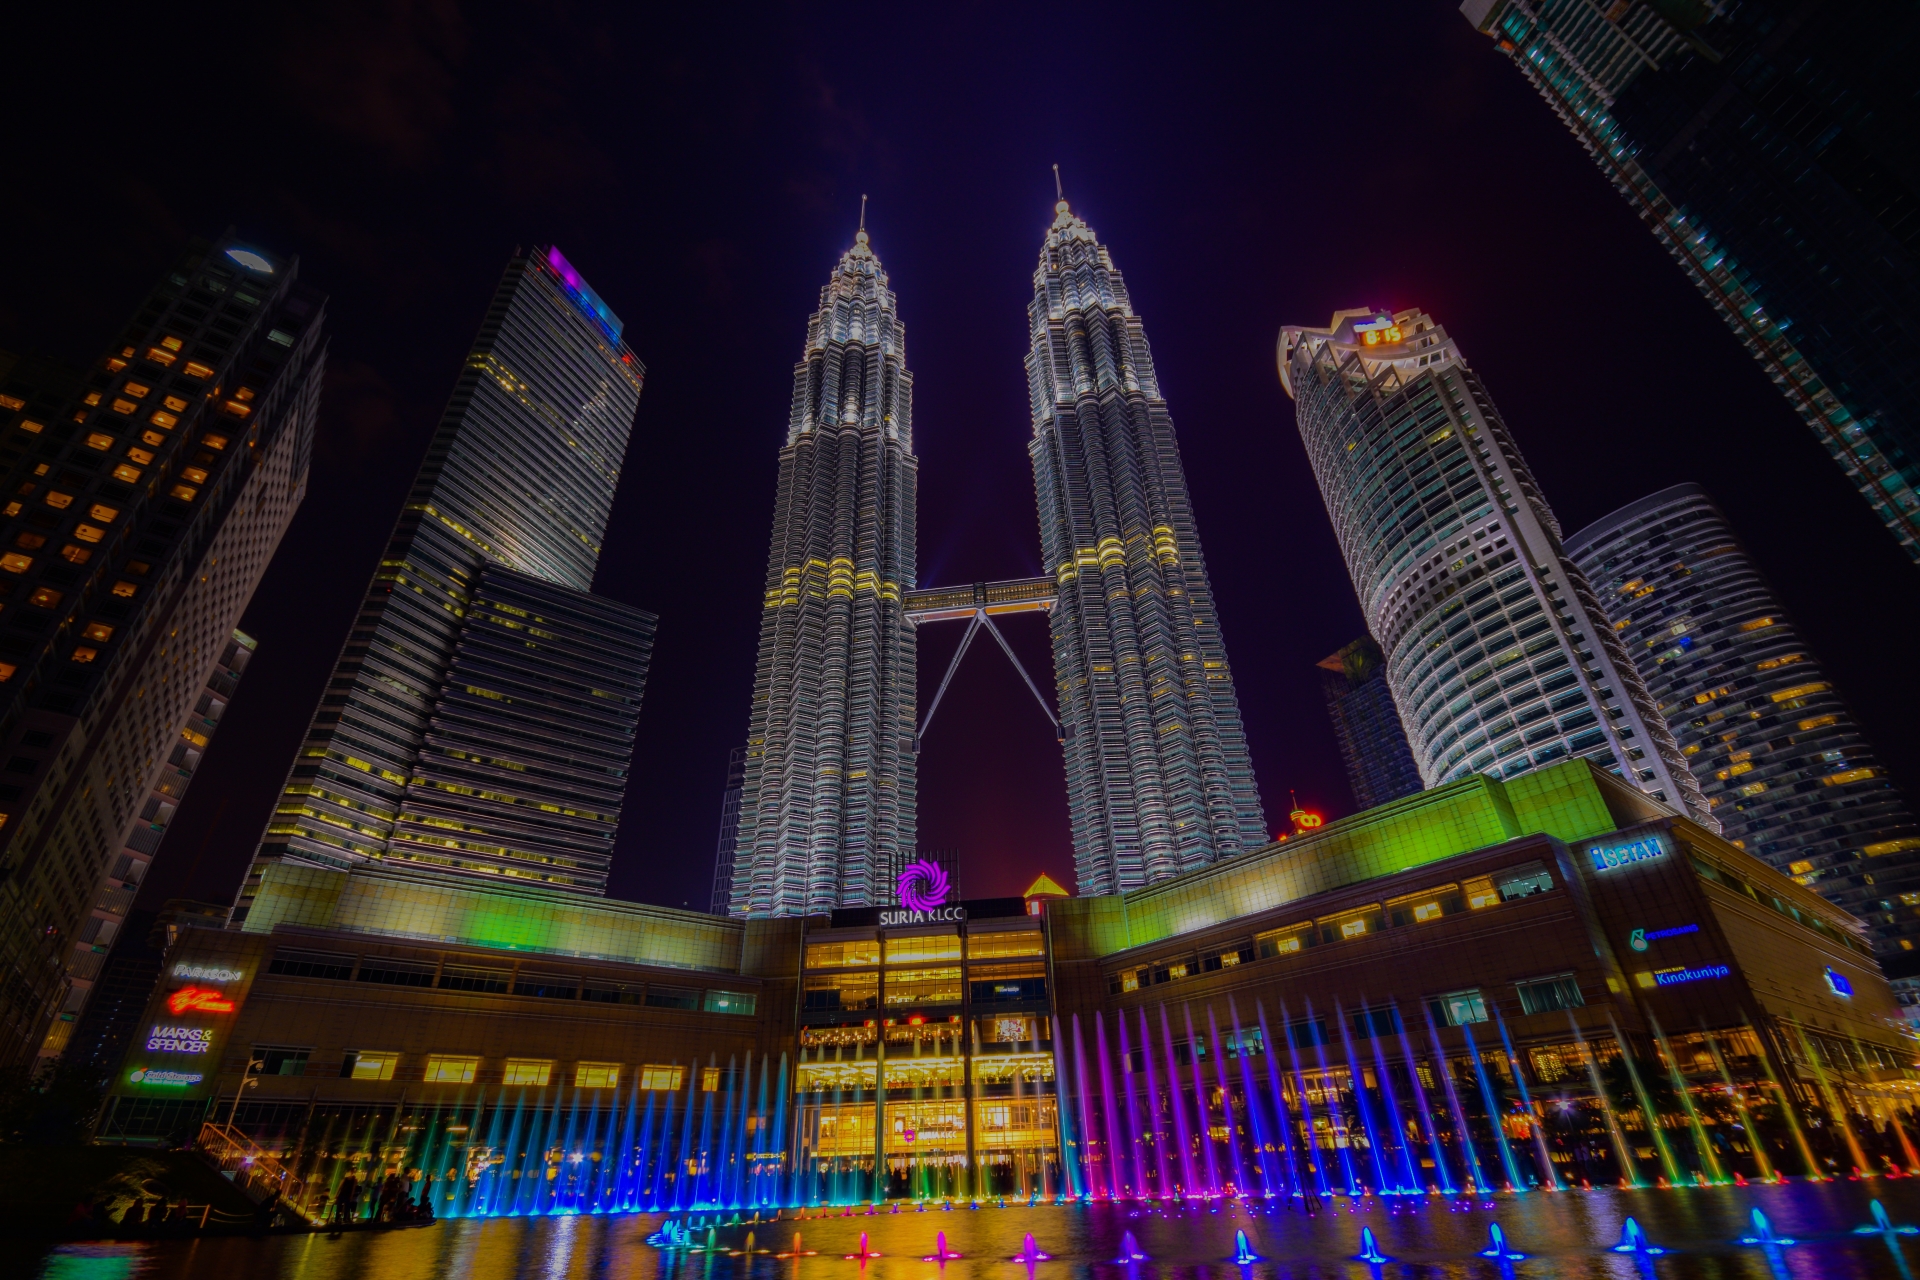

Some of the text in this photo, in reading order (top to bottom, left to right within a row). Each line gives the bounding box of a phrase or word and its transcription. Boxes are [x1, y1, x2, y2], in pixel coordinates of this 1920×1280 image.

[1366, 327, 1401, 345] 8:15
[880, 907, 963, 926] SURIA KLCC
[1645, 924, 1699, 940] PETROSAINS
[174, 965, 241, 981] PARKSON
[1656, 965, 1729, 985] Kinokuniya
[152, 1026, 212, 1041] MARKS &
[147, 1038, 209, 1053] SPENCER
[145, 1070, 166, 1080] Cold
[166, 1071, 202, 1083] Storage
